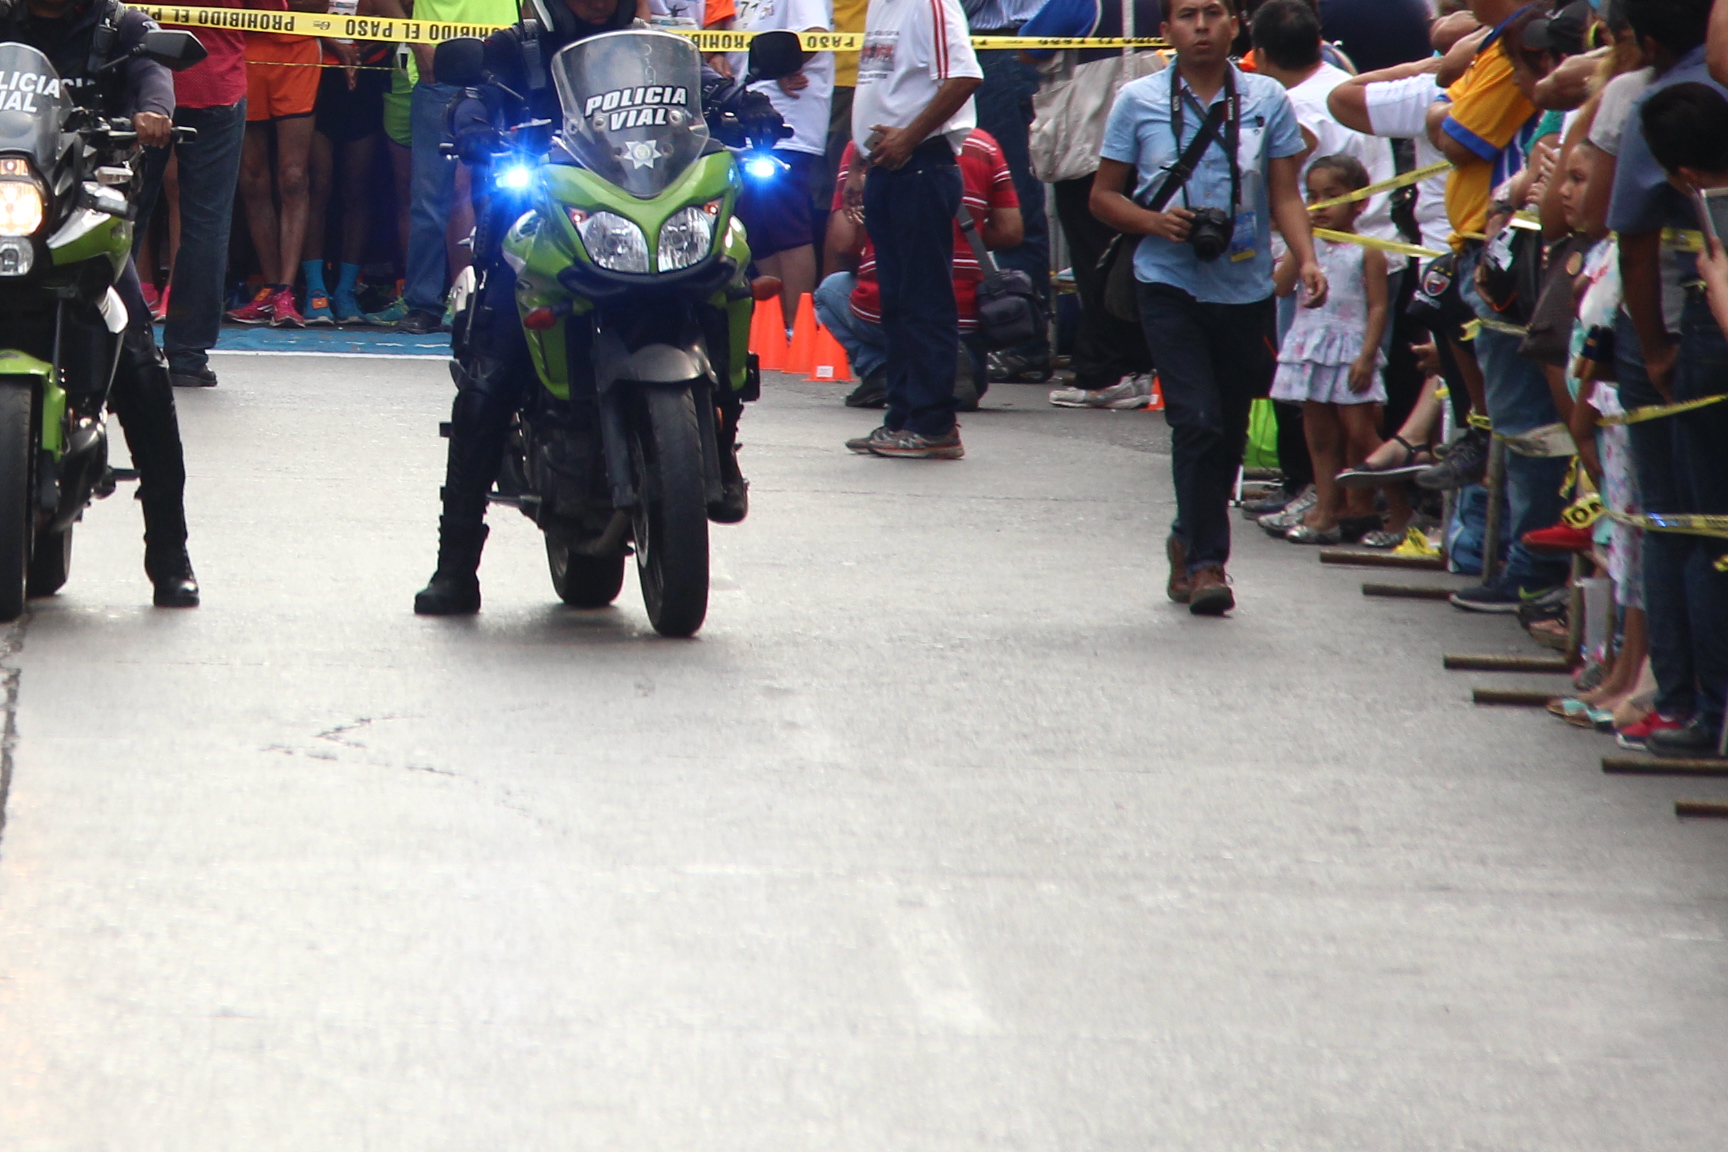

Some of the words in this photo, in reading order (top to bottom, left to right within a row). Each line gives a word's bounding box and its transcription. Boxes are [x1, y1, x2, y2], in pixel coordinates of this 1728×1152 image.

[171, 9, 190, 25] EL
[198, 10, 295, 32] PROHIBIDO
[345, 19, 393, 37] PASO
[402, 22, 420, 39] EL
[806, 35, 856, 48] PASO
[585, 86, 687, 117] POLICIA
[610, 108, 667, 131] VIAL
